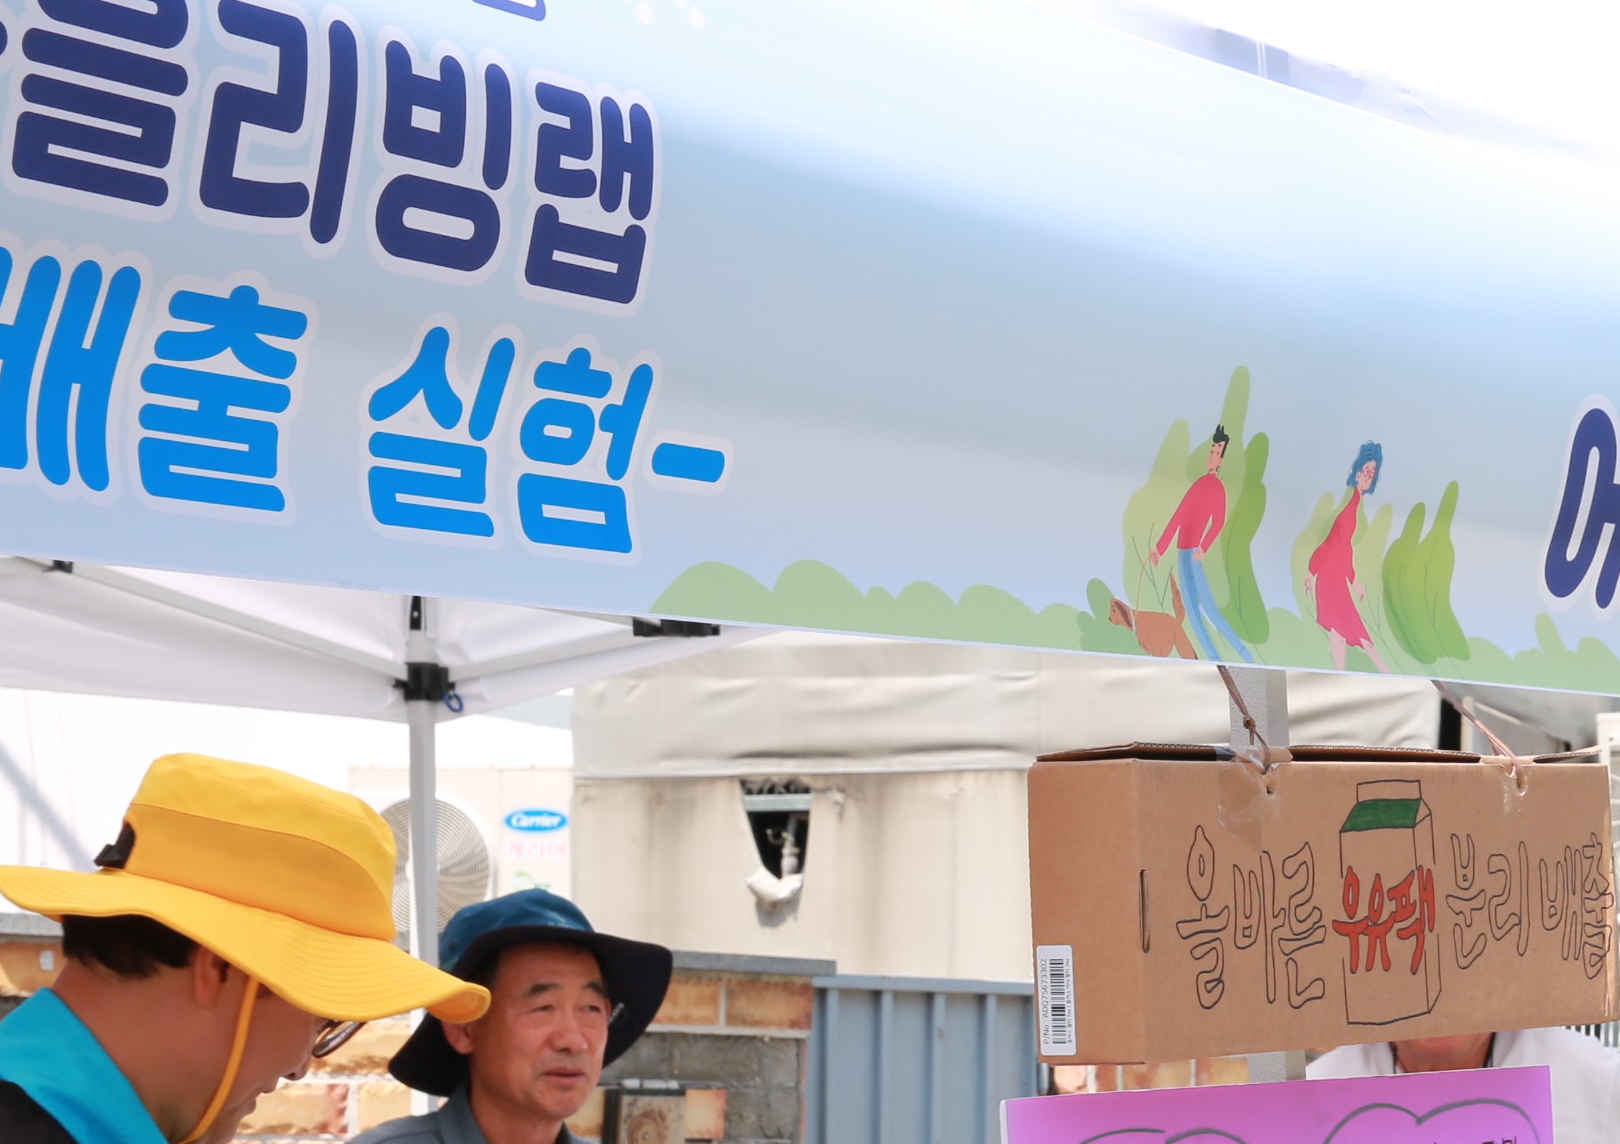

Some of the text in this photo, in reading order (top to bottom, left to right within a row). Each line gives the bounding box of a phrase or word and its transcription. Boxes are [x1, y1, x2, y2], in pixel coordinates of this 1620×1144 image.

[0, 0, 656, 305] 을리빙랩
[510, 813, 562, 828] Carrier
[1175, 824, 1327, 1010] 올바른
[1331, 864, 1436, 975] 우유팩
